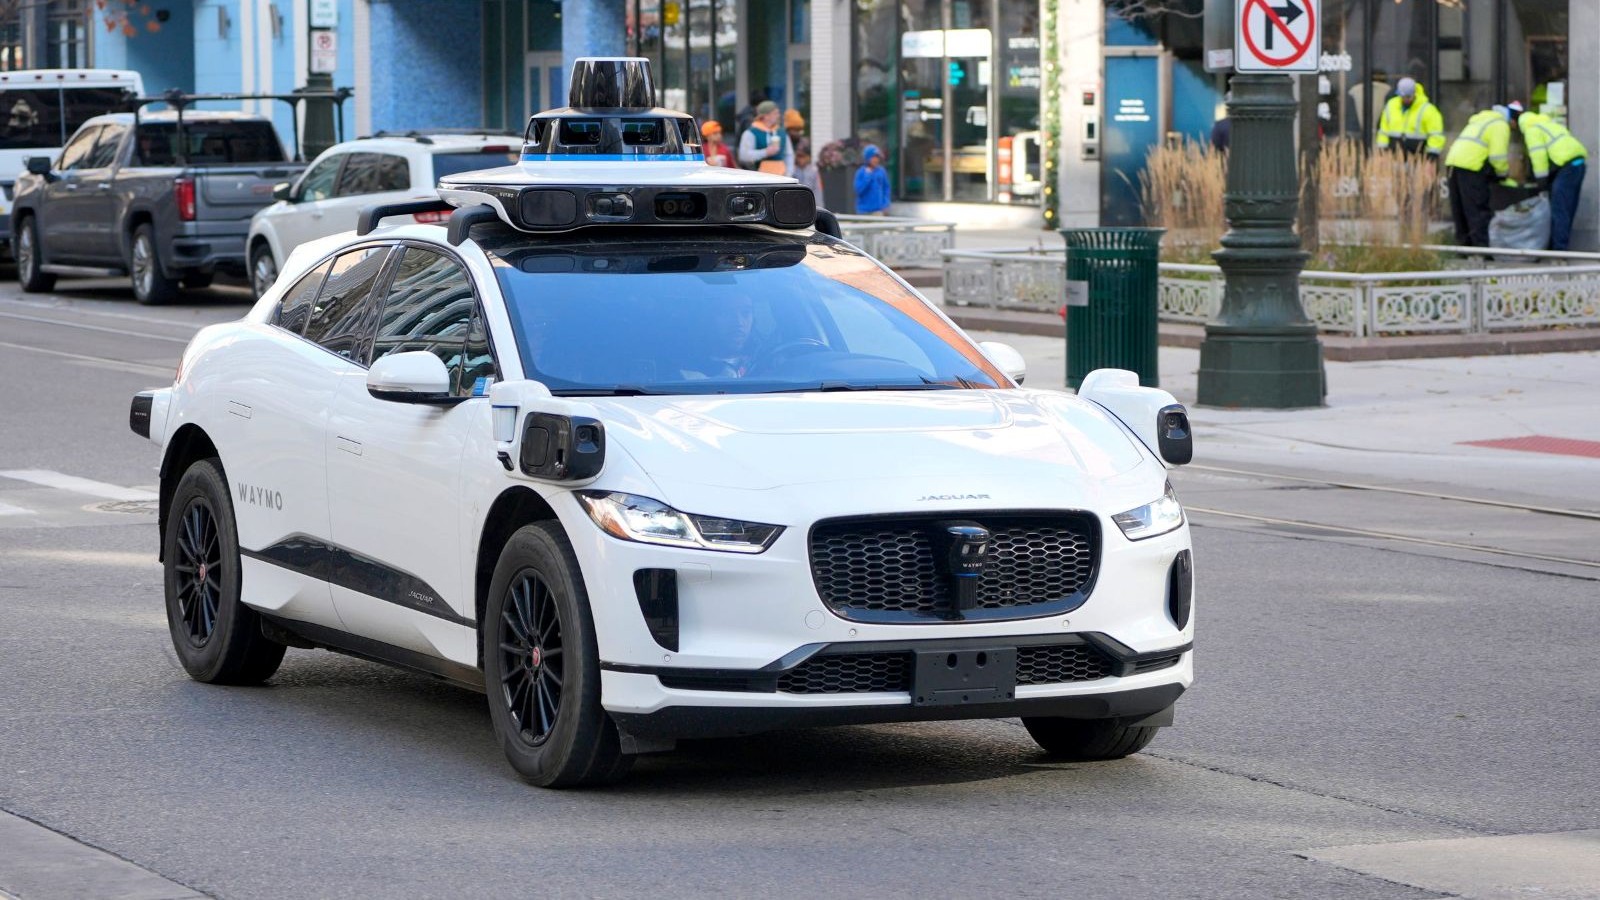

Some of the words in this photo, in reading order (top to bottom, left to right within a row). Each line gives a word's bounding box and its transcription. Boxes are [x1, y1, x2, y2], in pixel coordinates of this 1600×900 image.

[1319, 50, 1352, 72] dson's
[238, 482, 283, 511] WAYMO
[917, 494, 991, 502] JAGUAR
[408, 590, 433, 604] JAGUAR
